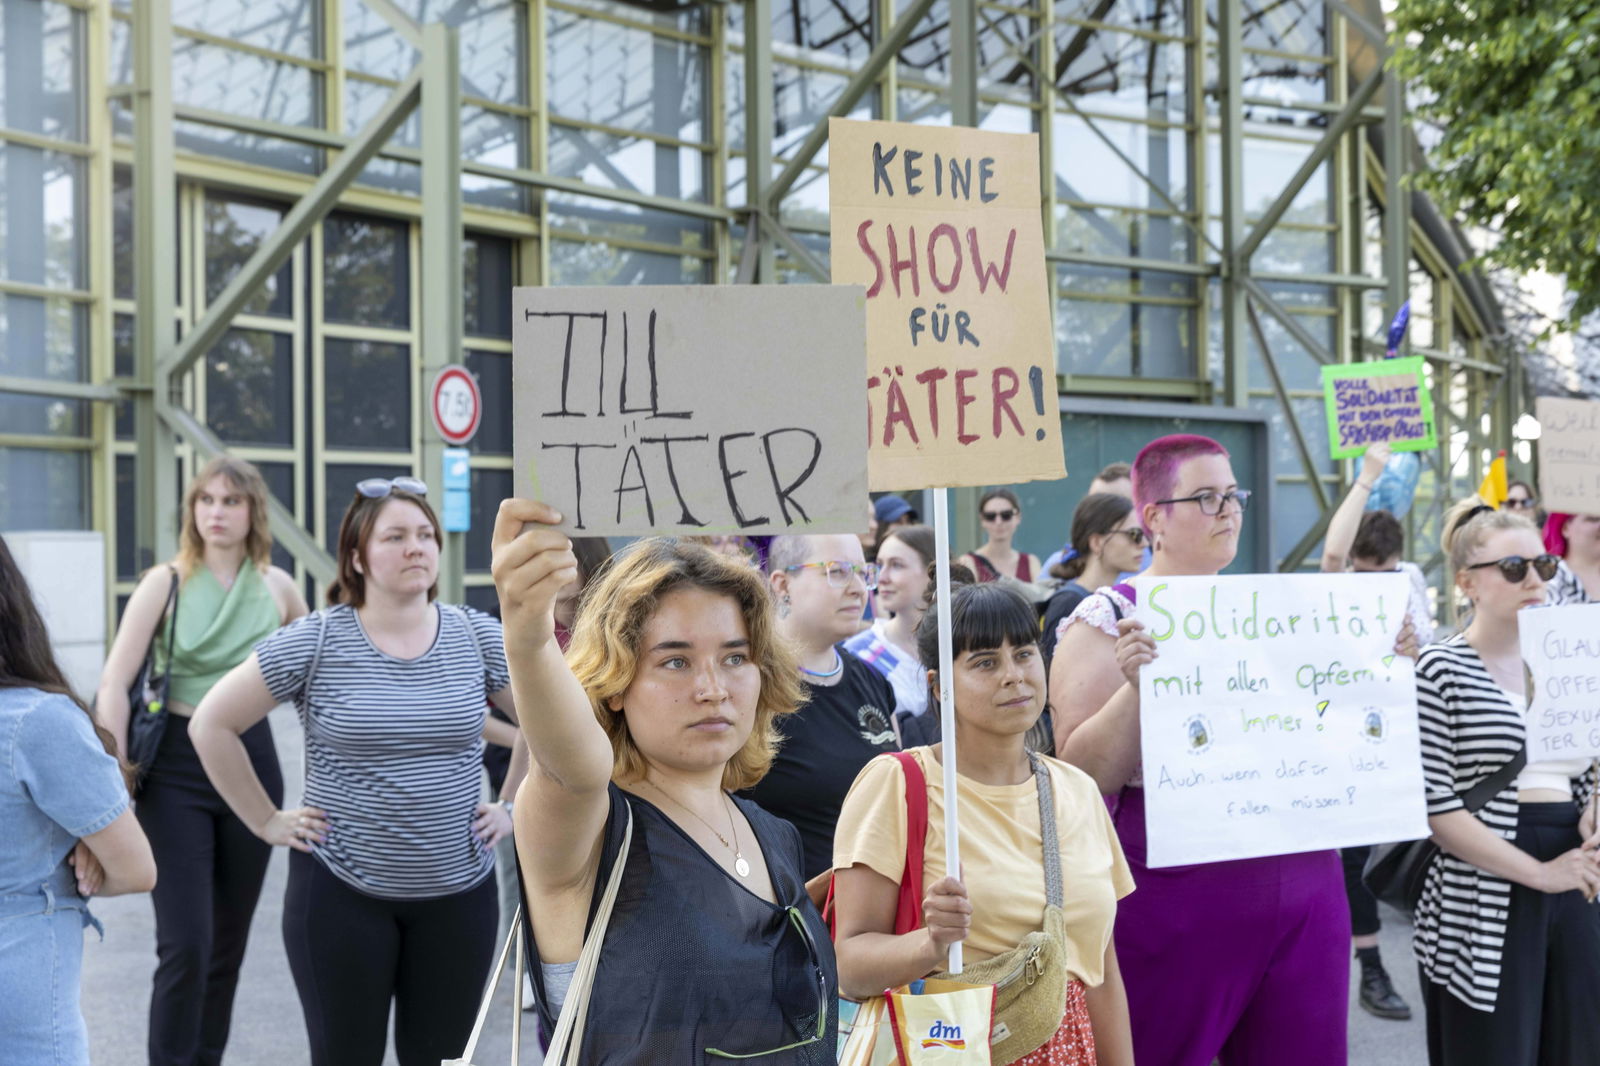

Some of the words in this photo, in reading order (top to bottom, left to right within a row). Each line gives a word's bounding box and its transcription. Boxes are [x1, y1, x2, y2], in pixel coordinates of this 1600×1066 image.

[873, 141, 999, 202] KEINE
[857, 220, 1016, 299] SHOW
[910, 303, 980, 347] FÜR
[525, 308, 694, 420] TILL
[541, 420, 822, 529] TÄTER
[1148, 584, 1388, 642] Solidarität
[1153, 666, 1203, 698] mit
[1227, 660, 1269, 692] allen
[1541, 732, 1578, 752] TER
[1222, 768, 1261, 783] wenn
[929, 1020, 961, 1039] dm
